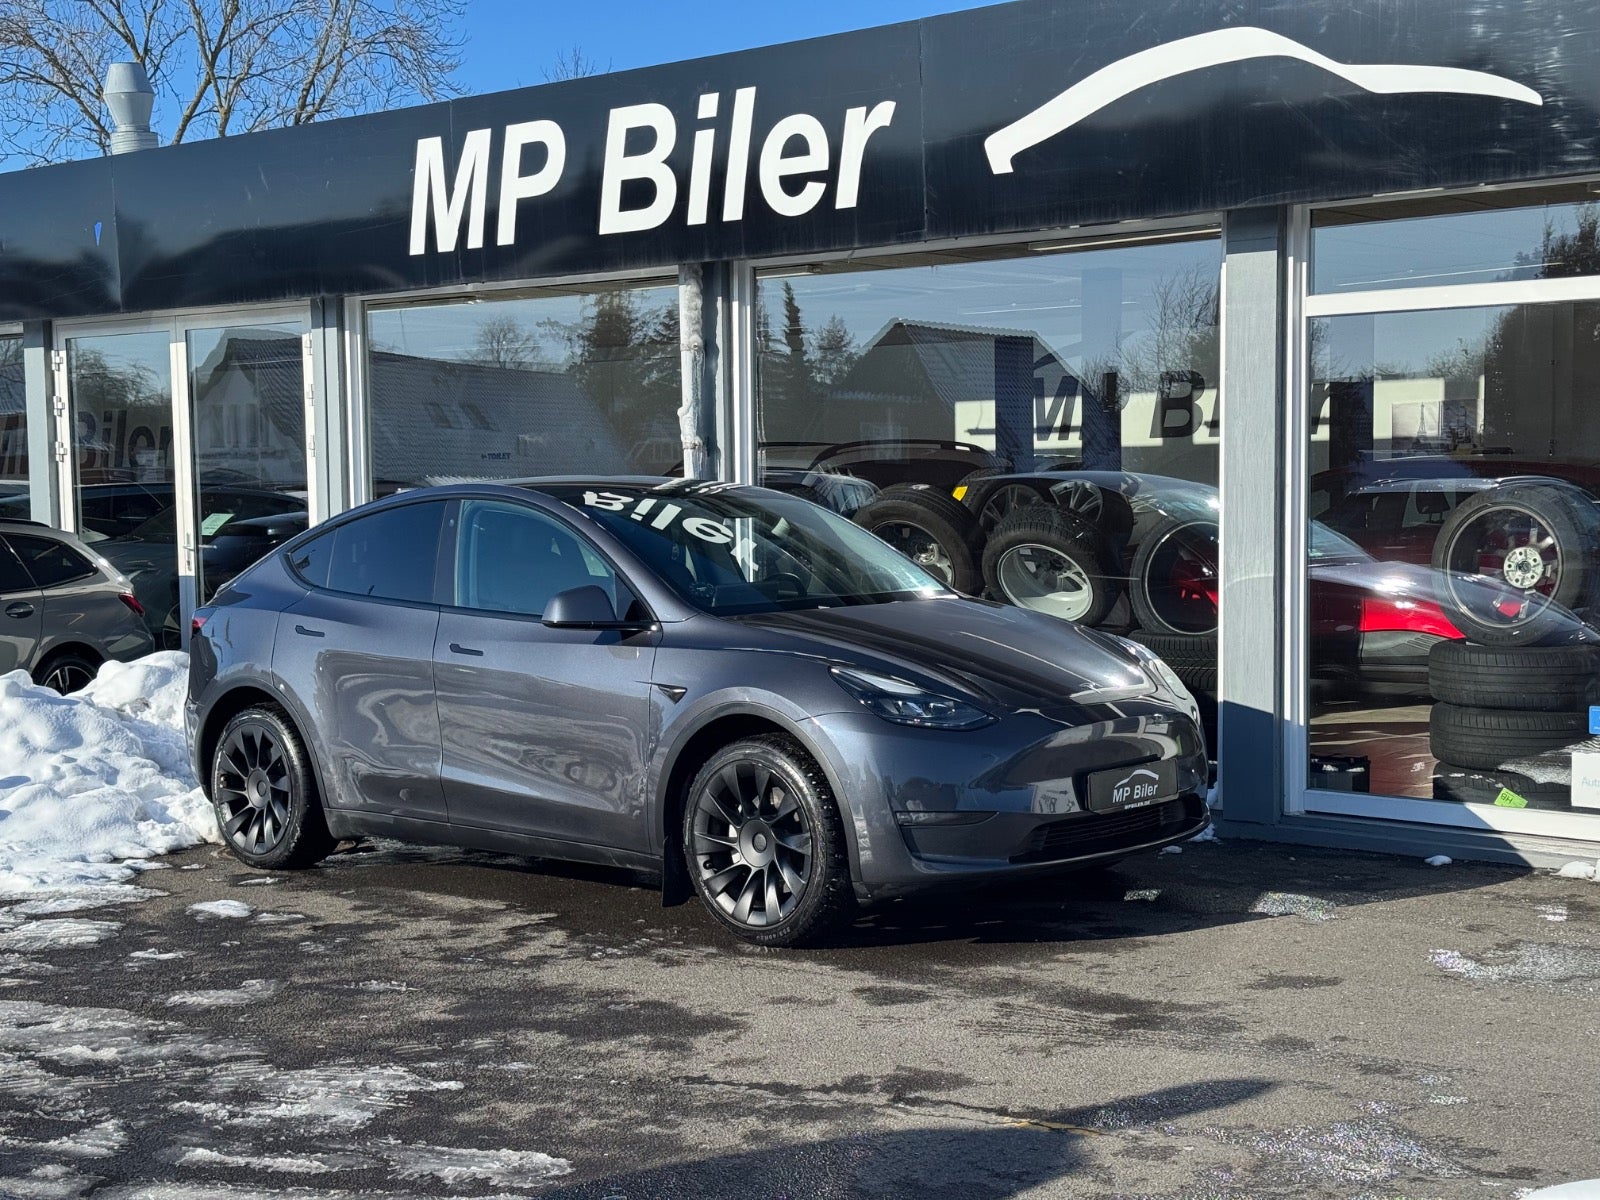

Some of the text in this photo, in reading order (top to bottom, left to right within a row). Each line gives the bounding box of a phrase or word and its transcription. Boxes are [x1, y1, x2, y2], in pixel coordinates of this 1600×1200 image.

[409, 86, 897, 256] MP Biler
[1112, 783, 1159, 804] MP Biler
